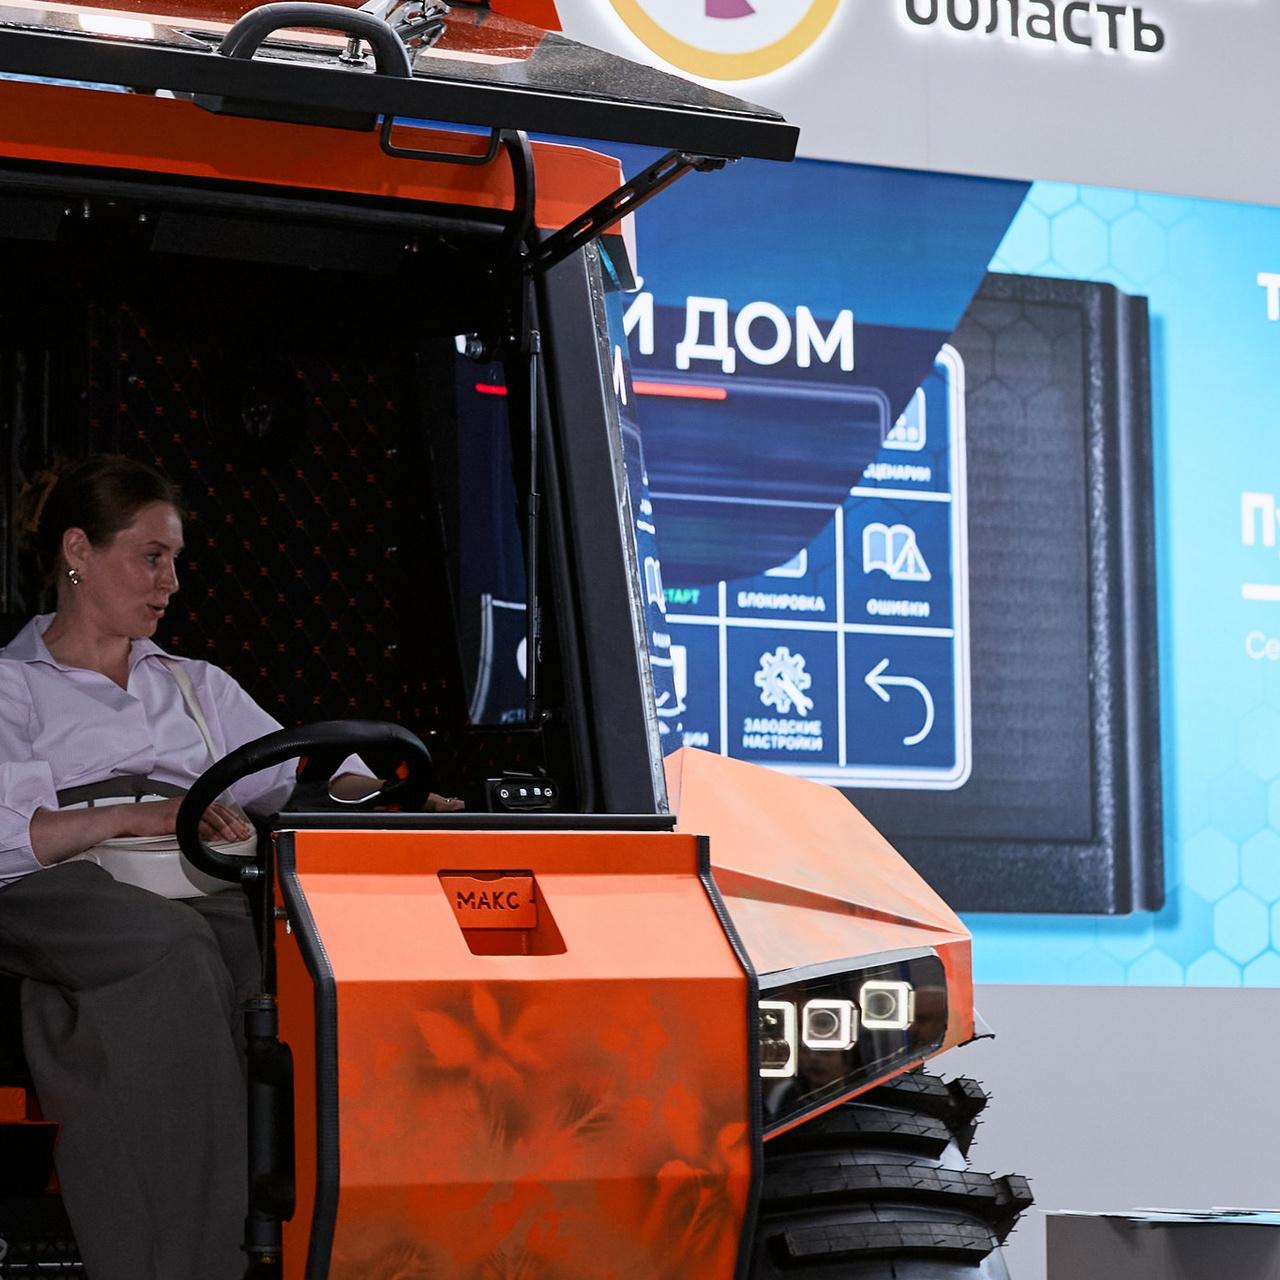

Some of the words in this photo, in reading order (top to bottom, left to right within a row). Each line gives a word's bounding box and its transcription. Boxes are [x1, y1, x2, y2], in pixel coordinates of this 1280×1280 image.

[675, 295, 855, 374] ДОМ
[1241, 492, 1280, 548] П
[737, 590, 826, 612] БЛОКИРОВКА
[866, 598, 931, 618] ОШИБКИ
[743, 716, 822, 737] ЗАВОДСКИЕ
[742, 732, 824, 752] НАСТРОЙКИ
[456, 890, 520, 910] МАКС
